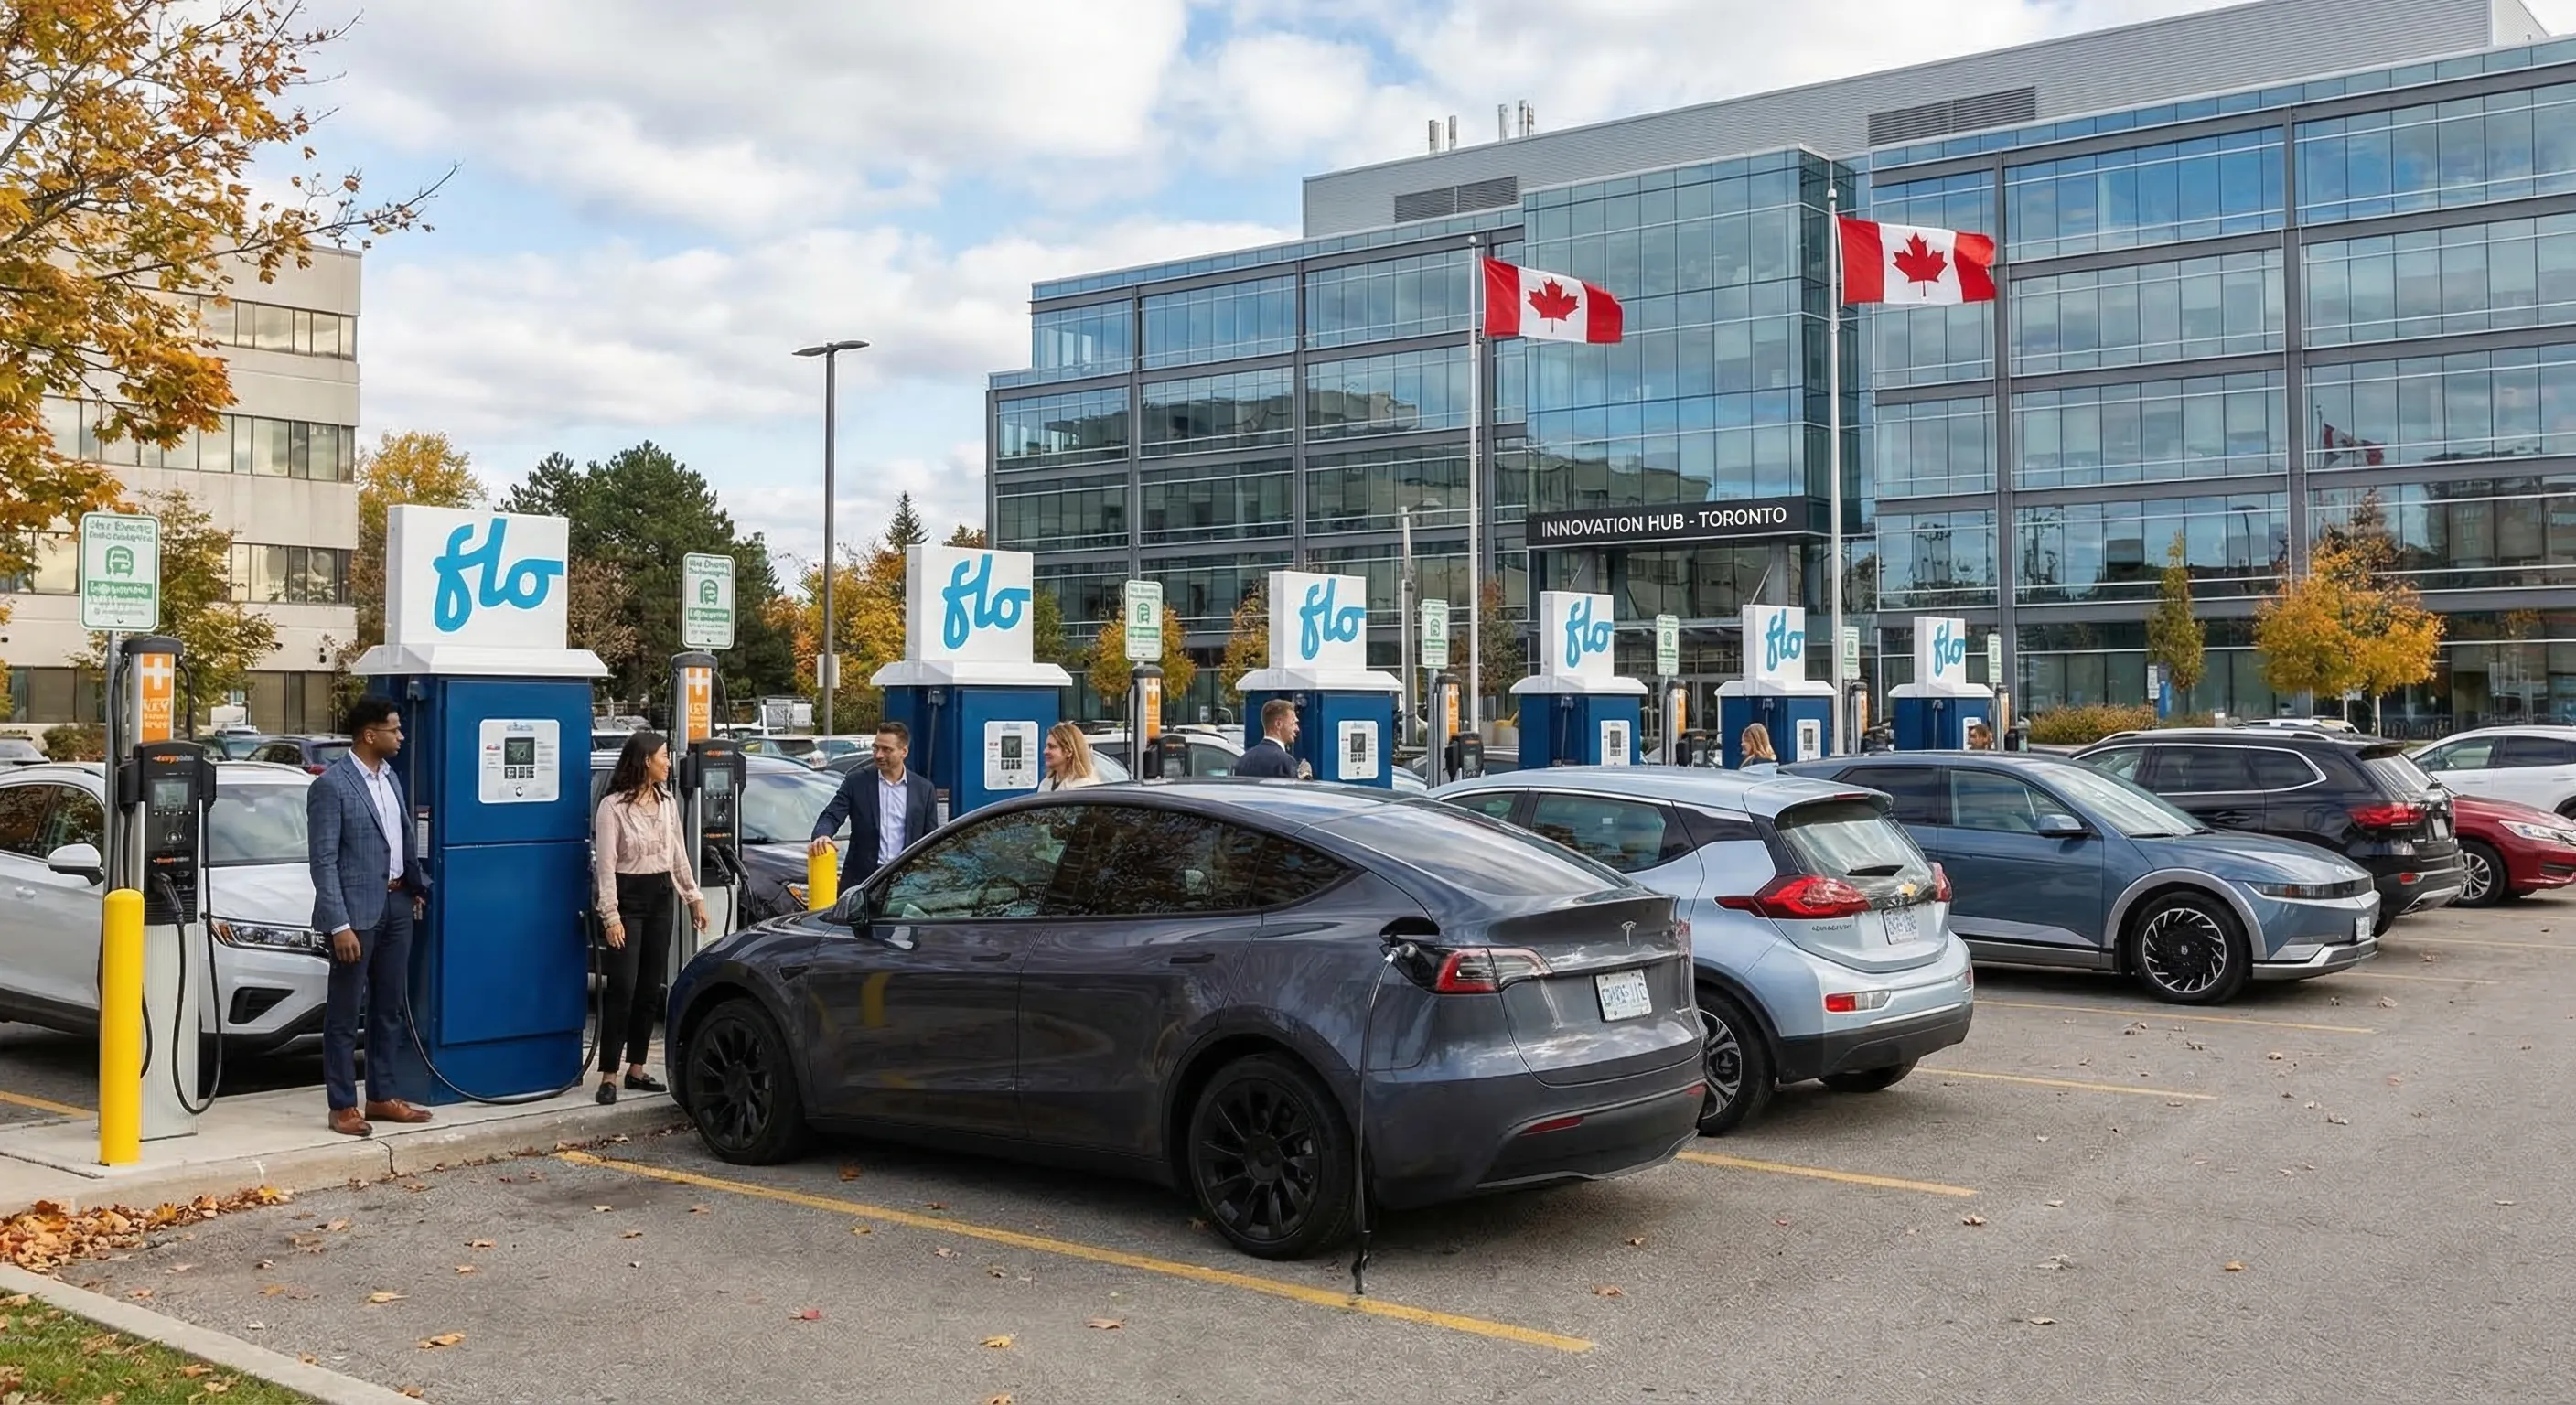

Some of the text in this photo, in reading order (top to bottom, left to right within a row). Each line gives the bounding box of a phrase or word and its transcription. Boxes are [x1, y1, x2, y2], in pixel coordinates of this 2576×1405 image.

[1541, 516, 1644, 538] INNOVATION
[1648, 513, 1684, 531] HUB
[1698, 506, 1787, 528] TORONTO
[433, 518, 564, 632] flo
[942, 553, 1031, 650] flo
[1299, 577, 1366, 660] flo
[1566, 595, 1614, 668] flo
[1765, 608, 1805, 672] flo
[1933, 619, 1965, 677] flo
